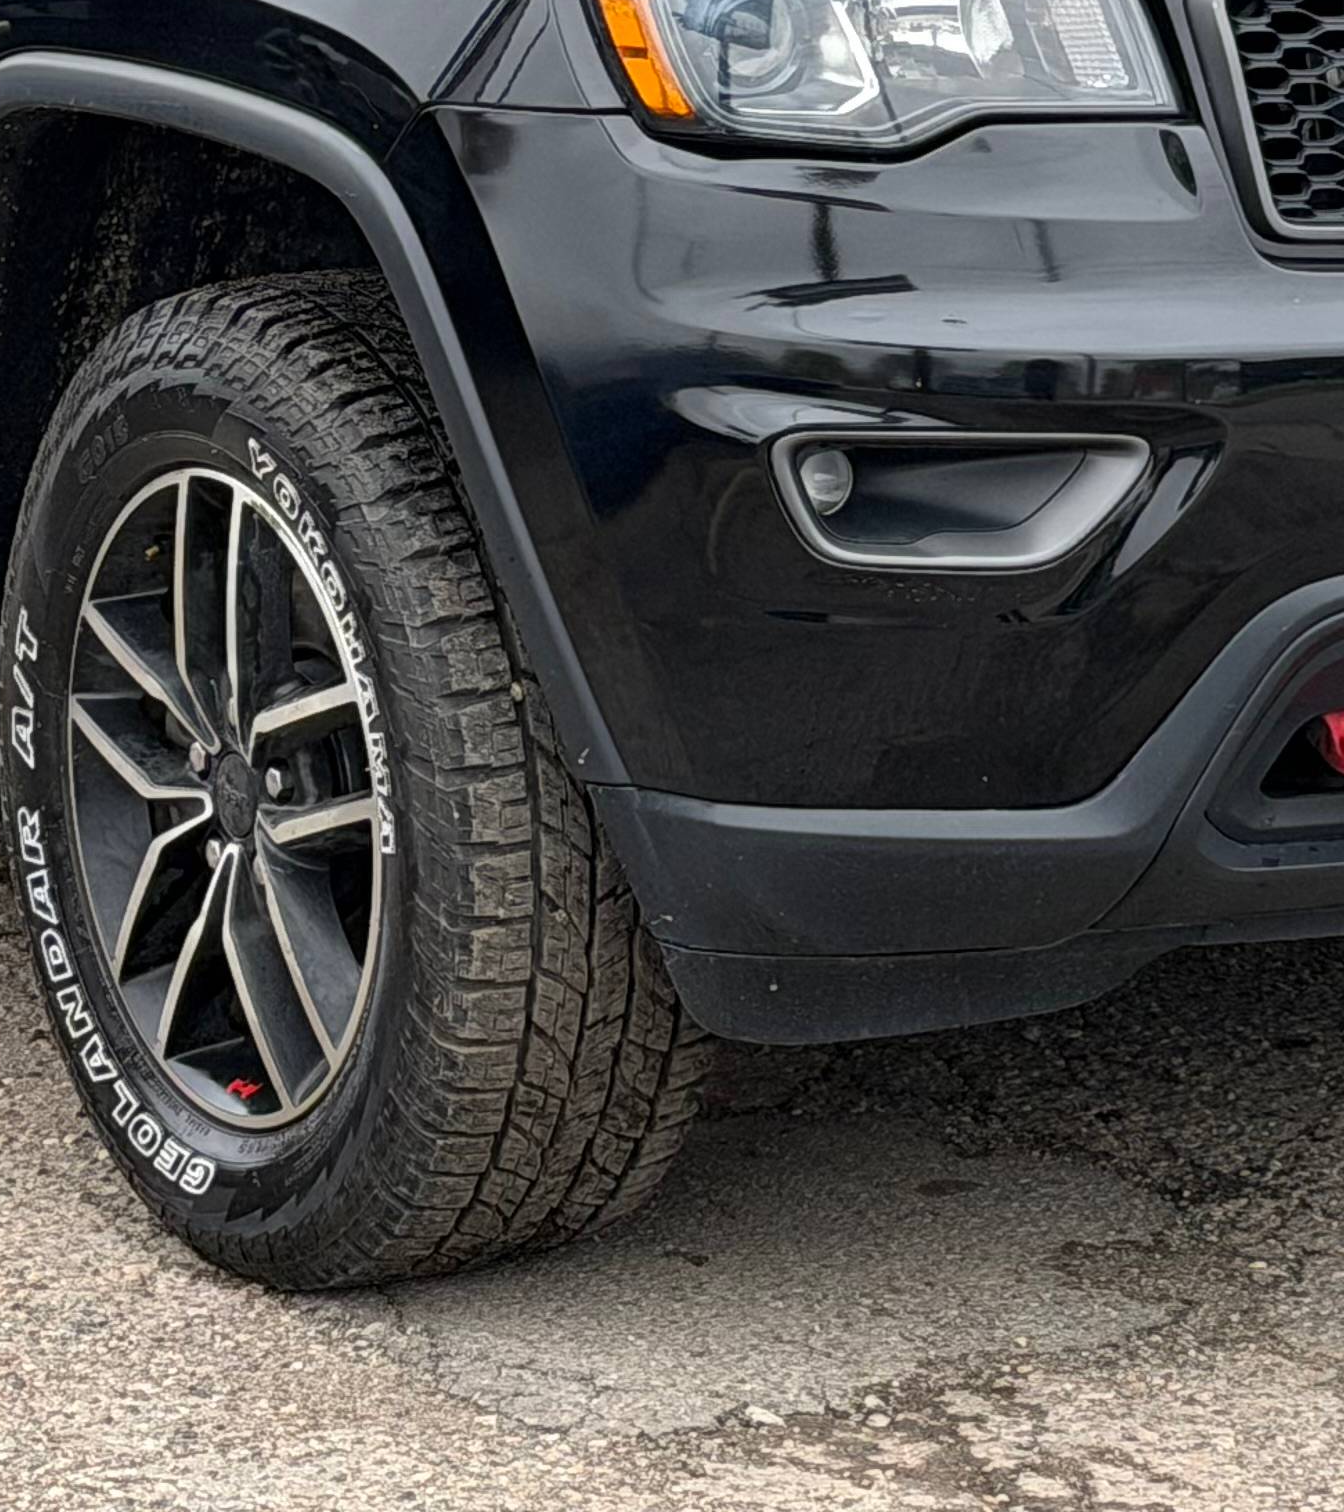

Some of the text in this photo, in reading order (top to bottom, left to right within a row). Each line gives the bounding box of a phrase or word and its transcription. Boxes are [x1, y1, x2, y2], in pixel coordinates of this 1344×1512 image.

[11, 604, 39, 771] A/T
[247, 437, 397, 854] YOKOHAMA
[17, 805, 216, 1195] GEOLANDAR
